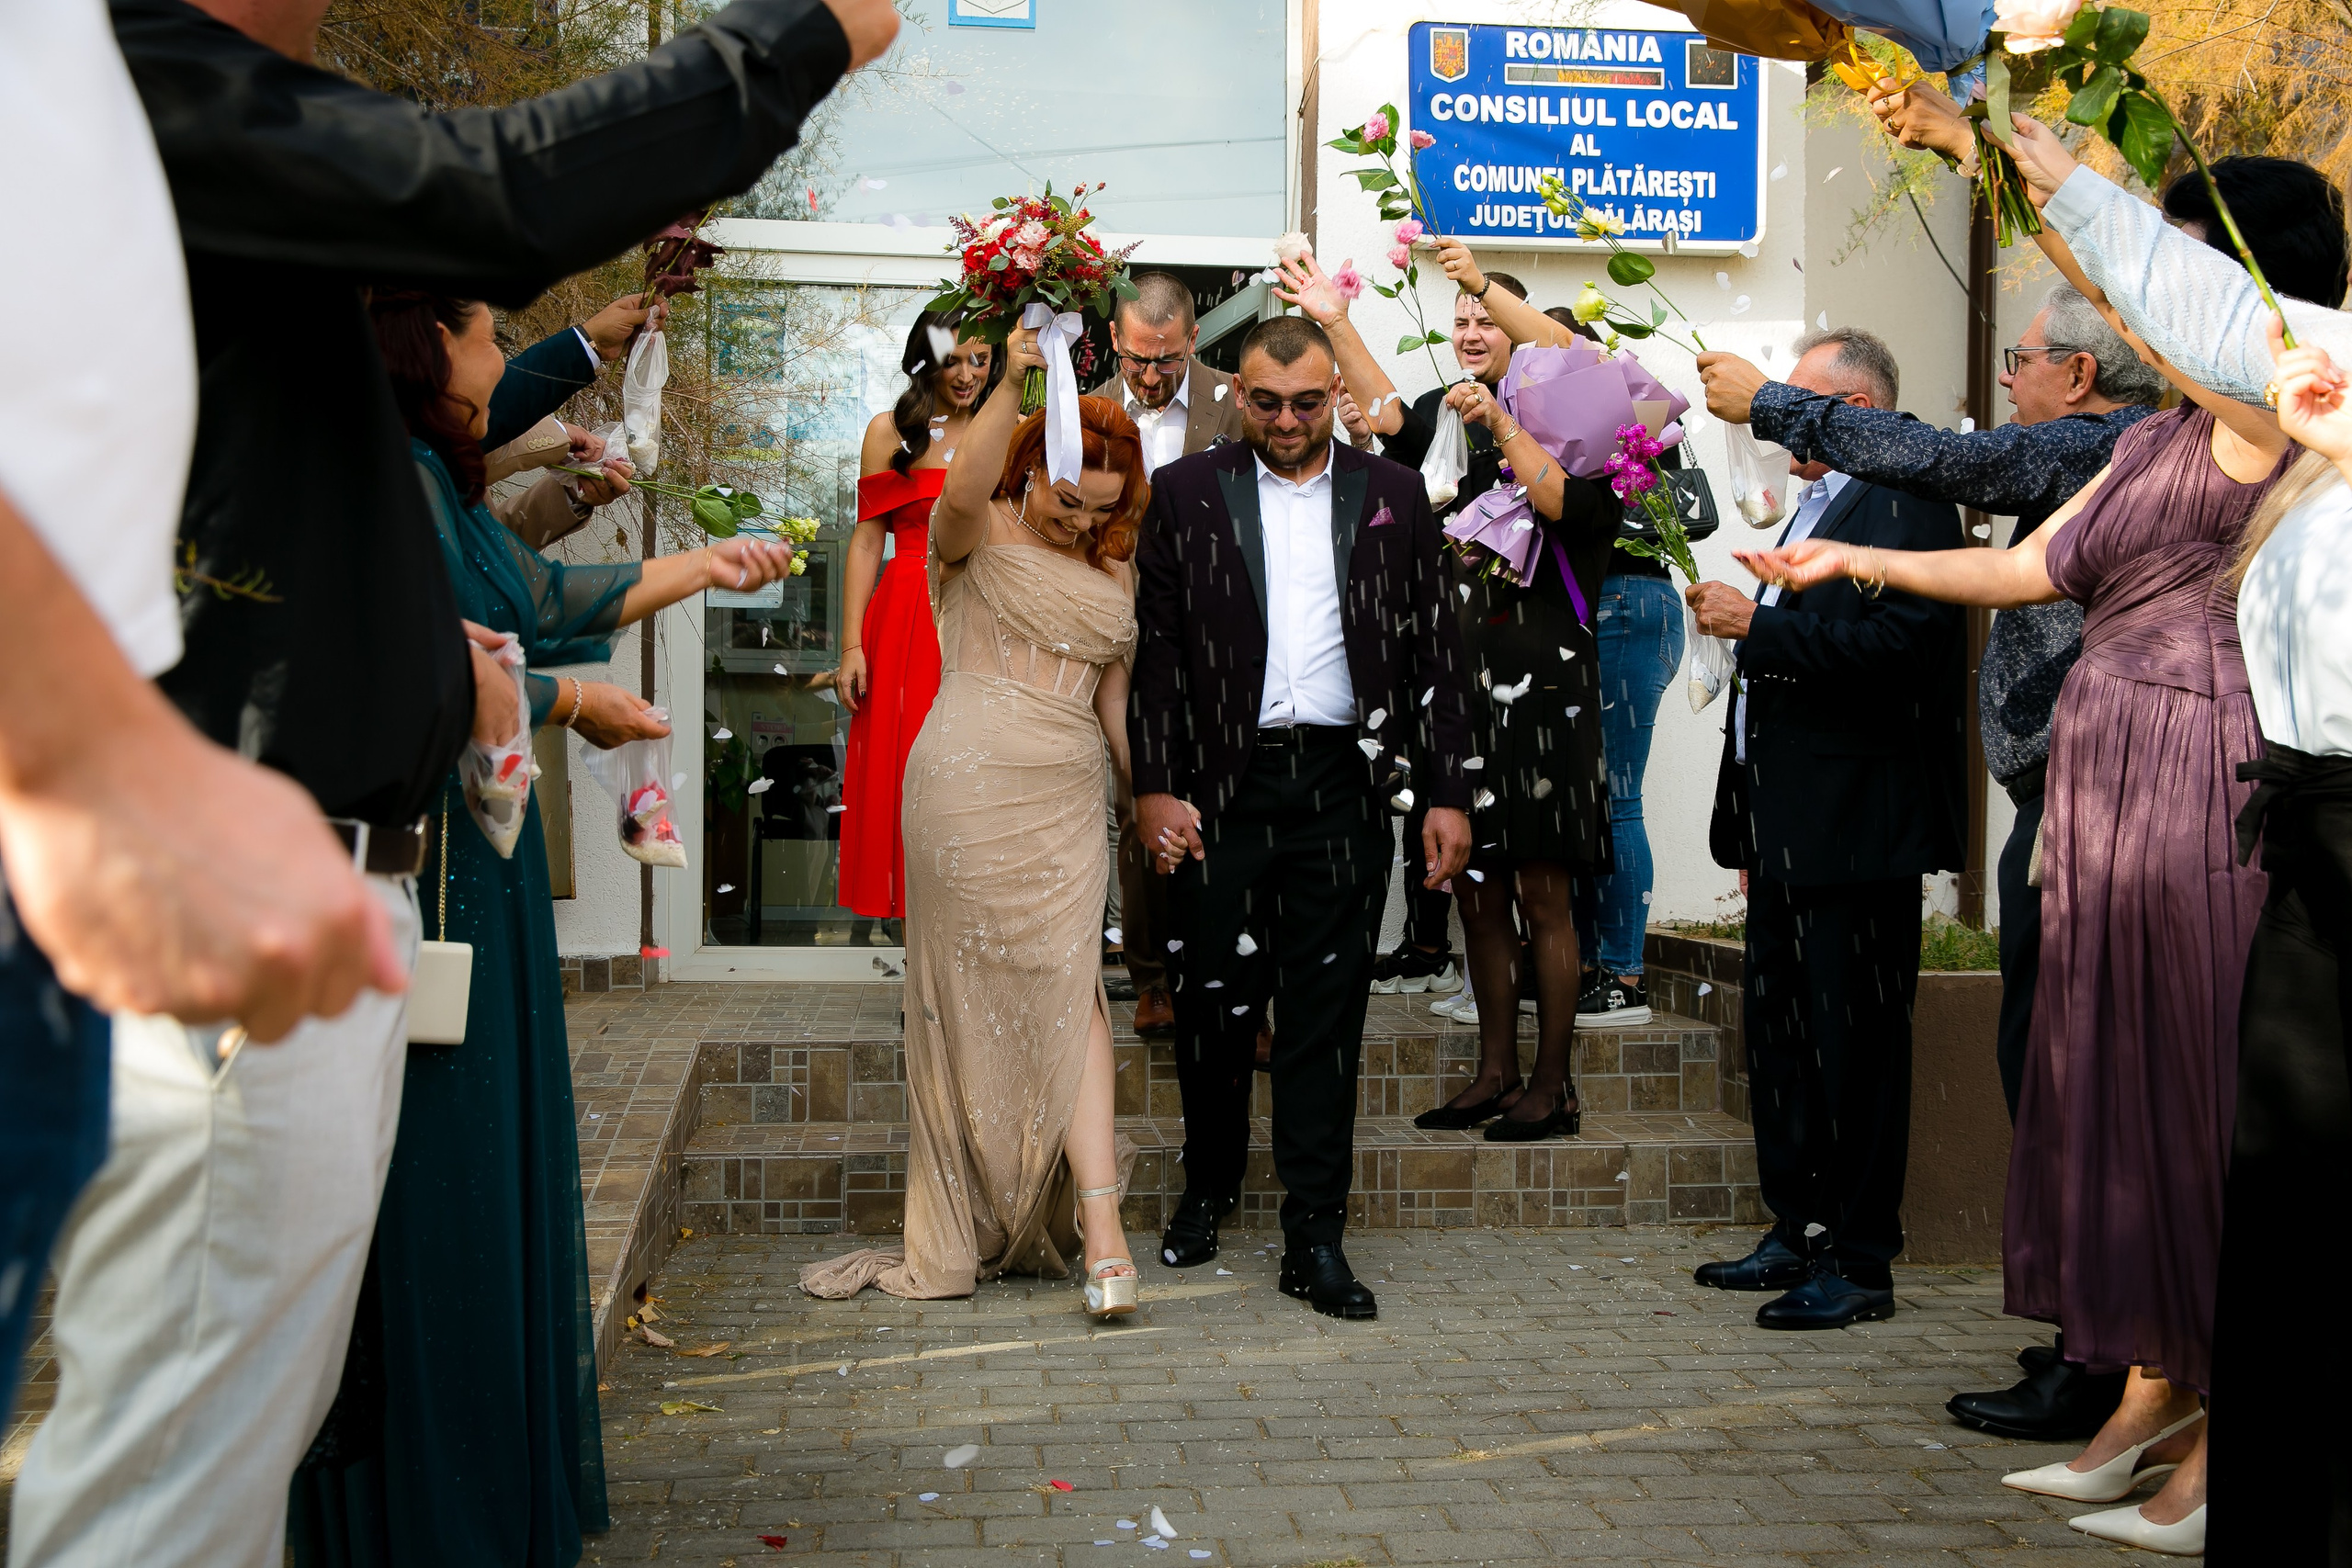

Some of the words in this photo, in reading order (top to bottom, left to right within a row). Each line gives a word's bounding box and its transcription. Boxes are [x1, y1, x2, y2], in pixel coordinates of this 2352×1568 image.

[1505, 28, 1663, 63] ROMÂNIA
[1430, 92, 1617, 127] CONSILIUL
[1626, 99, 1738, 130] LOCAL
[1569, 133, 1601, 157] AL
[1589, 202, 1702, 240] ĂLĂRAȘI
